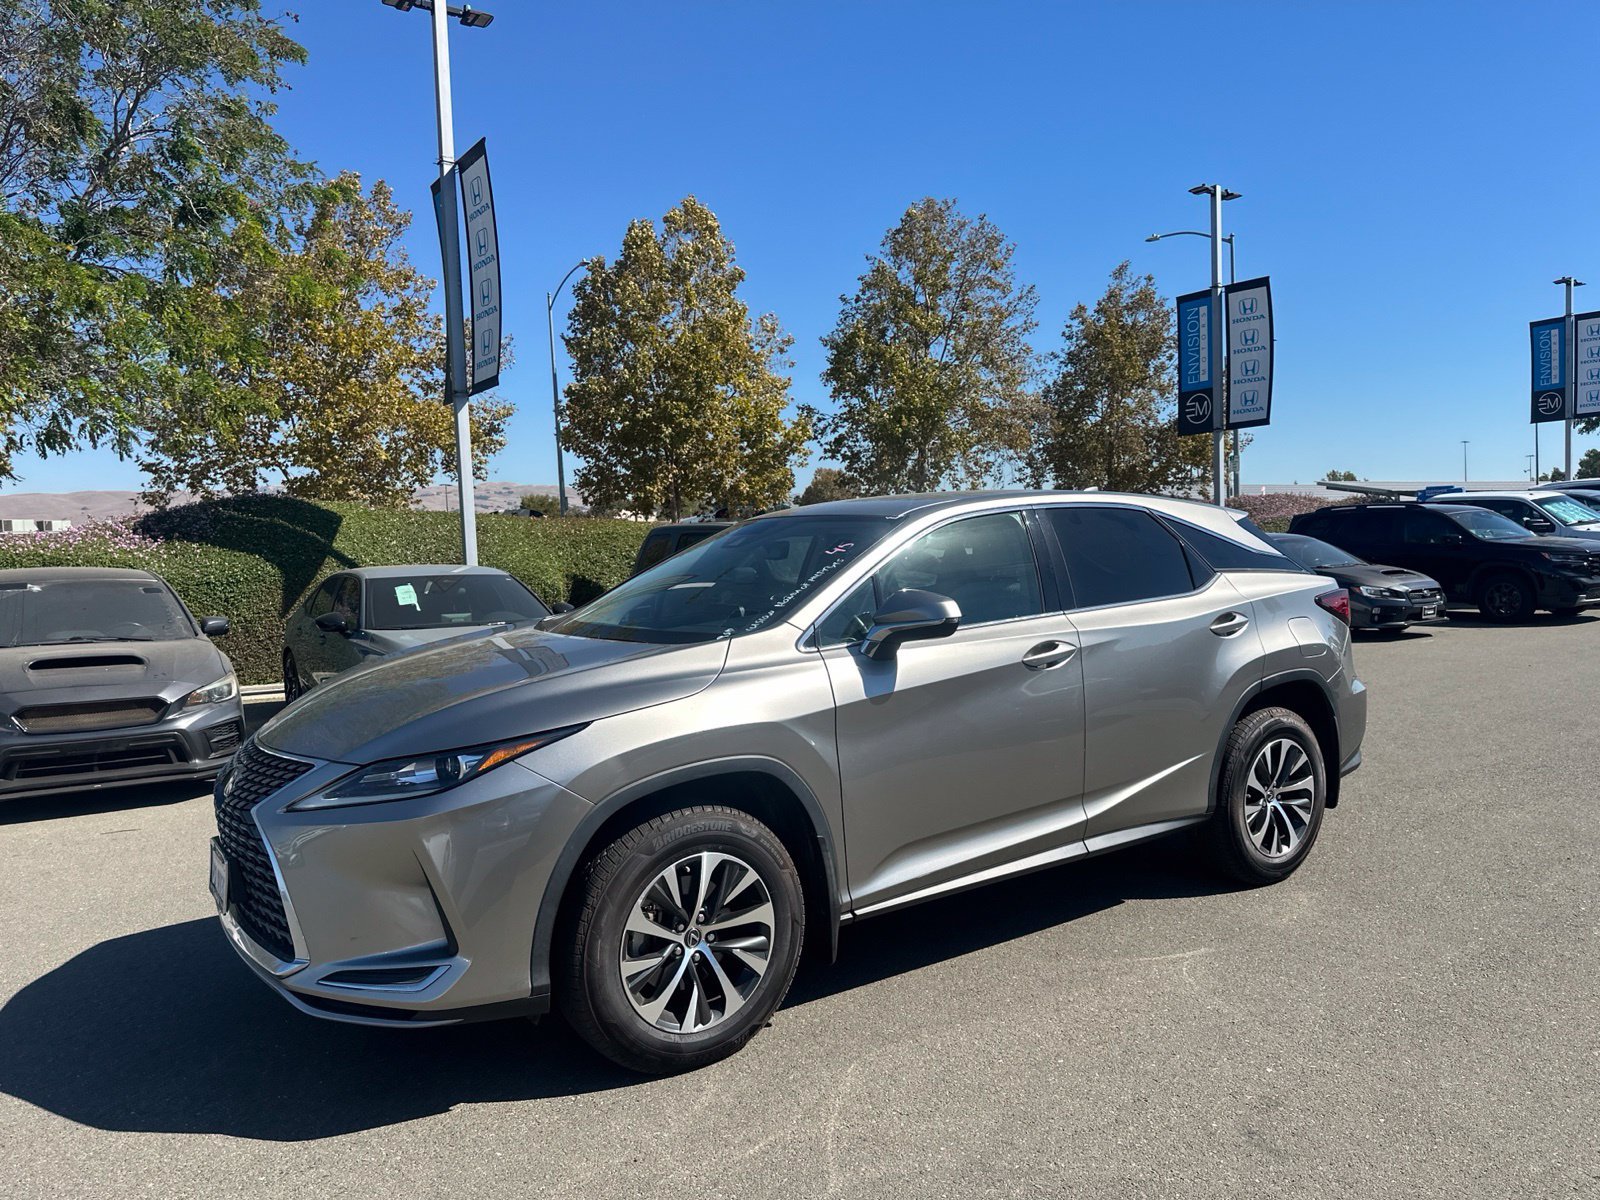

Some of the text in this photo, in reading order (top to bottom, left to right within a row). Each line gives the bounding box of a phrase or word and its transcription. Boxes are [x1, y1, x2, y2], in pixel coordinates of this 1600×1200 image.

[469, 203, 490, 222] HONDA
[473, 254, 496, 273] HONDA
[475, 305, 498, 322] HONDA
[1232, 314, 1266, 324] HONDA
[1187, 307, 1200, 384] ENVISION
[1233, 345, 1267, 355] HONDA
[475, 355, 497, 370] HONDA
[1540, 330, 1551, 386] ENVISION
[1233, 376, 1266, 385] HONDA
[1232, 406, 1264, 415] HONDA
[651, 820, 733, 849] BRIDGESTONE
